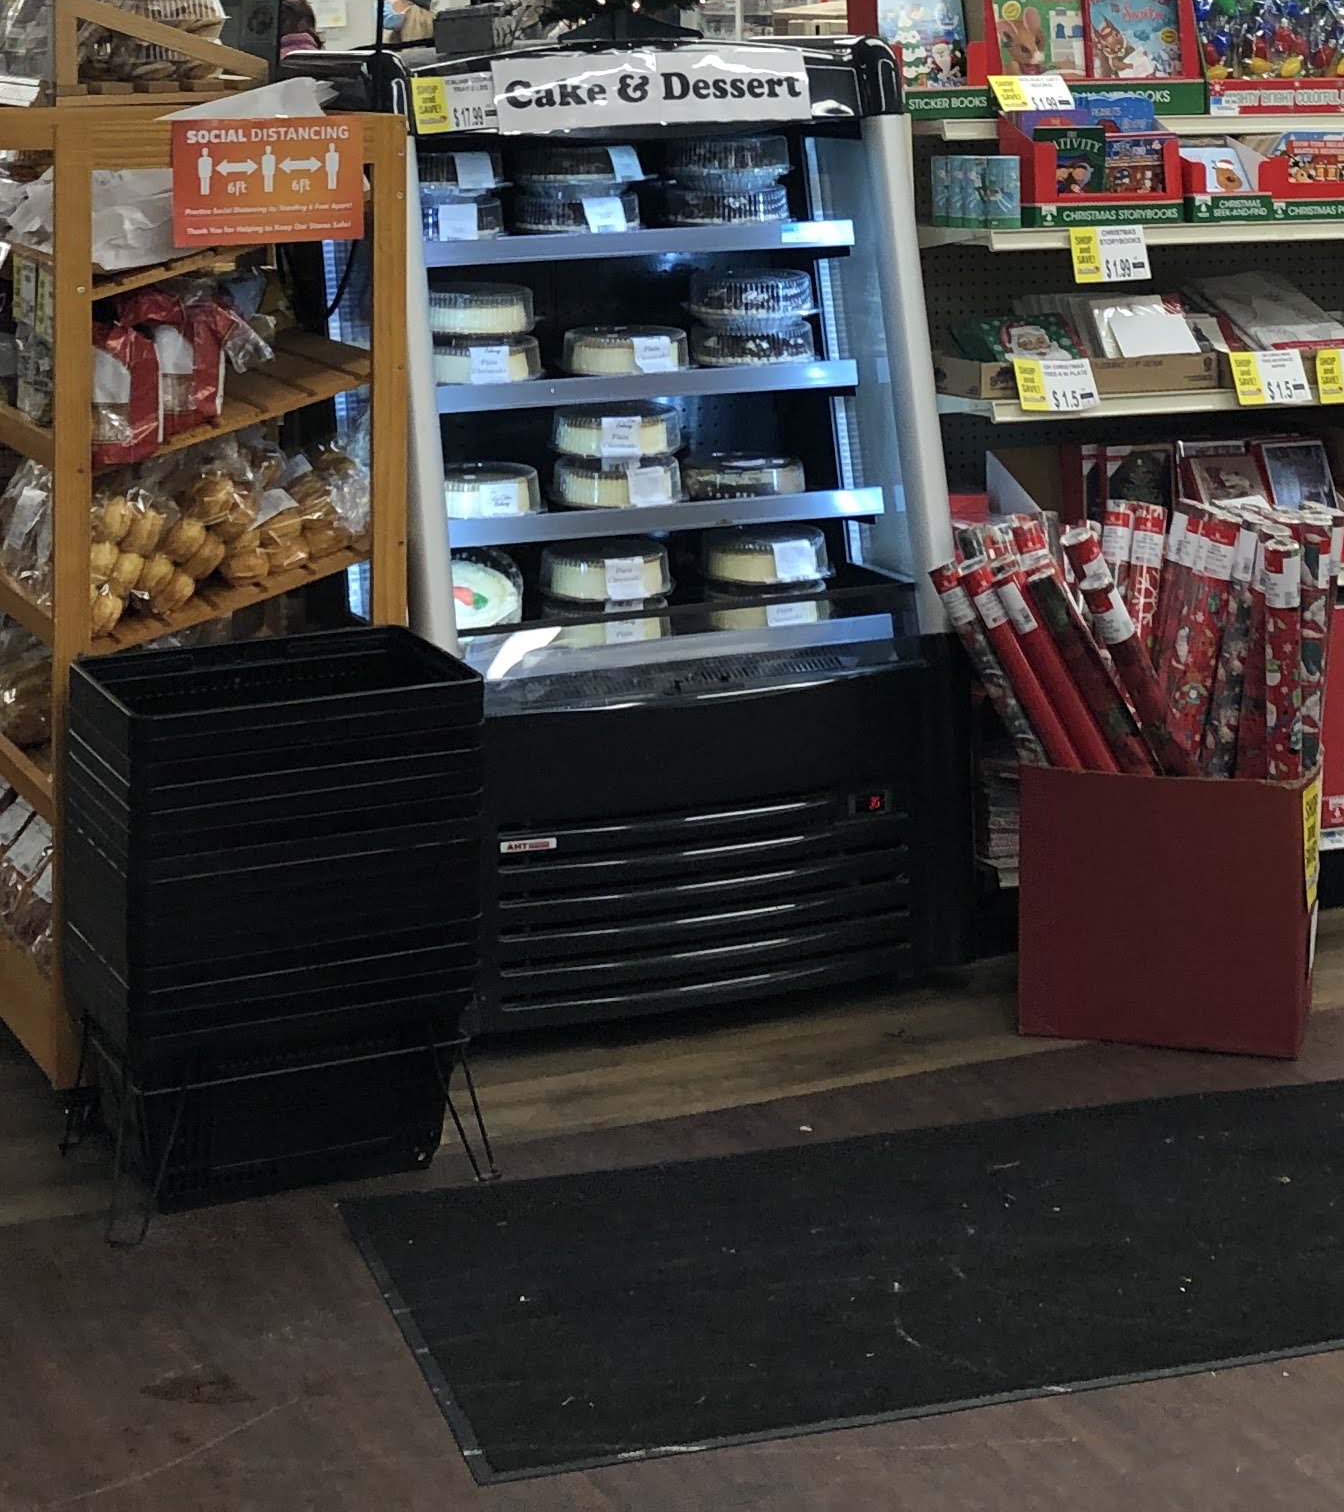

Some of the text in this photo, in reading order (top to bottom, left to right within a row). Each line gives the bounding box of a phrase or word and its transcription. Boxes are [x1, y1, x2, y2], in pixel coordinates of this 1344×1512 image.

[505, 71, 802, 109] Cake & Dessert
[908, 96, 988, 111] STICKER BOOKS
[186, 125, 350, 143] SOCIAL DISTANCING
[1053, 137, 1103, 154] ATIVITY
[227, 180, 248, 196] 6ft
[291, 178, 311, 193] 6ft
[1219, 199, 1261, 209] CHRISTMAS
[1288, 205, 1336, 216] CHRISTMAS
[1063, 208, 1178, 221] CHRISTMAS STORYBOOKS
[1105, 258, 1132, 279] $1.99
